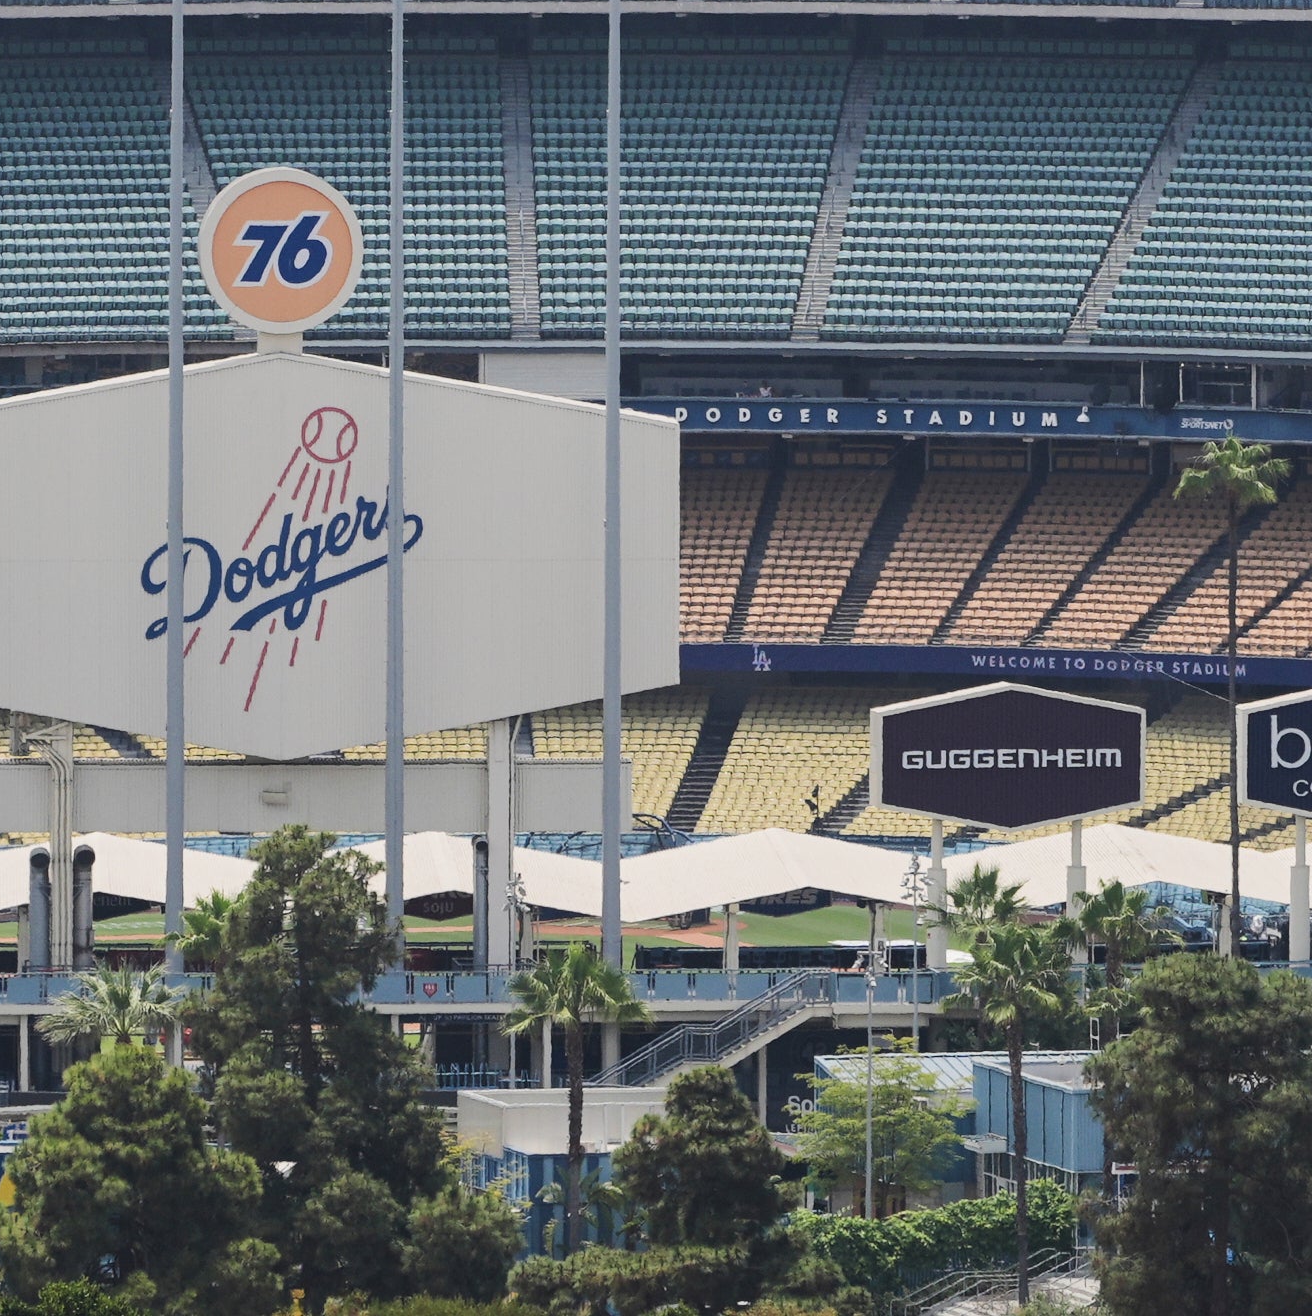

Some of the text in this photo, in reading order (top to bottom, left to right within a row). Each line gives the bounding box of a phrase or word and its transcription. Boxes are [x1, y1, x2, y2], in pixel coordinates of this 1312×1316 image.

[237, 213, 330, 286] 76
[675, 407, 1060, 428] DODGER STADIUM
[140, 484, 424, 641] Dodgers
[752, 643, 772, 672] LA
[971, 655, 1247, 677] WELCOME TO DODGER STADIUM
[901, 748, 1123, 770] GUGGENHEIM
[423, 902, 454, 913] SOJU
